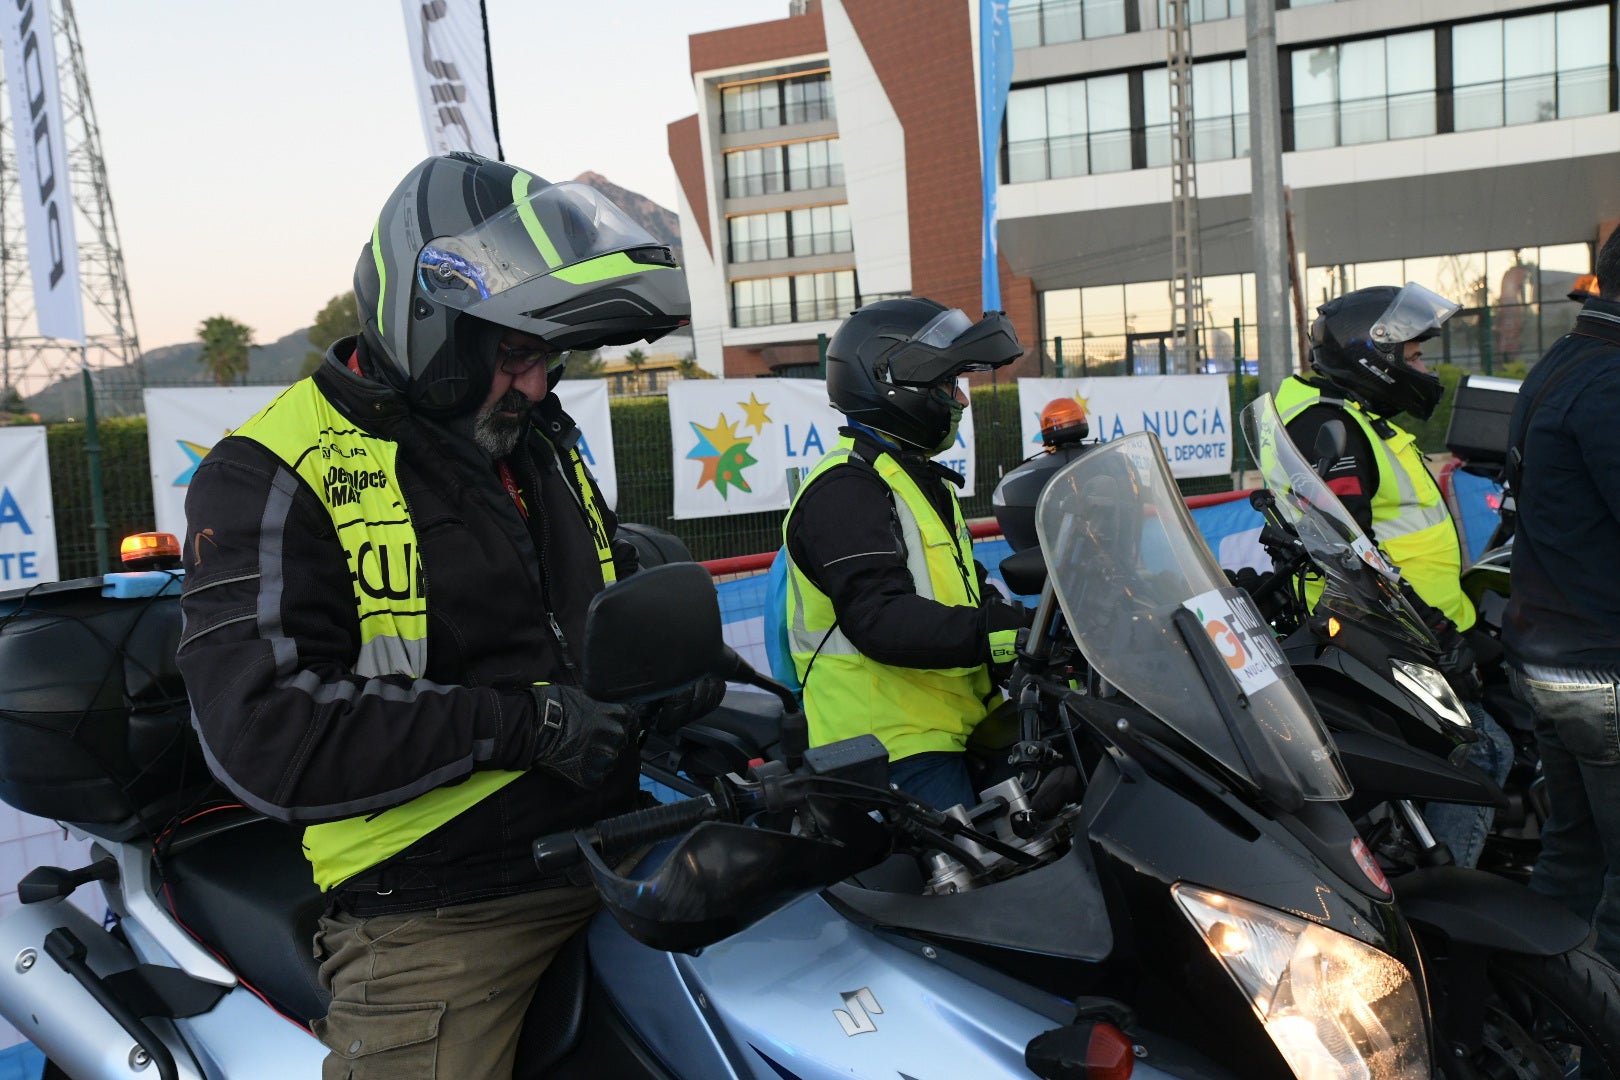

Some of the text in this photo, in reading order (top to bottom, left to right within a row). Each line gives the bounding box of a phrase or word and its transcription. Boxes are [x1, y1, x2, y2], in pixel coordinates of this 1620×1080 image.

[784, 421, 826, 457] LA
[1098, 413, 1125, 443] LA
[1175, 442, 1226, 461] DEPORTE
